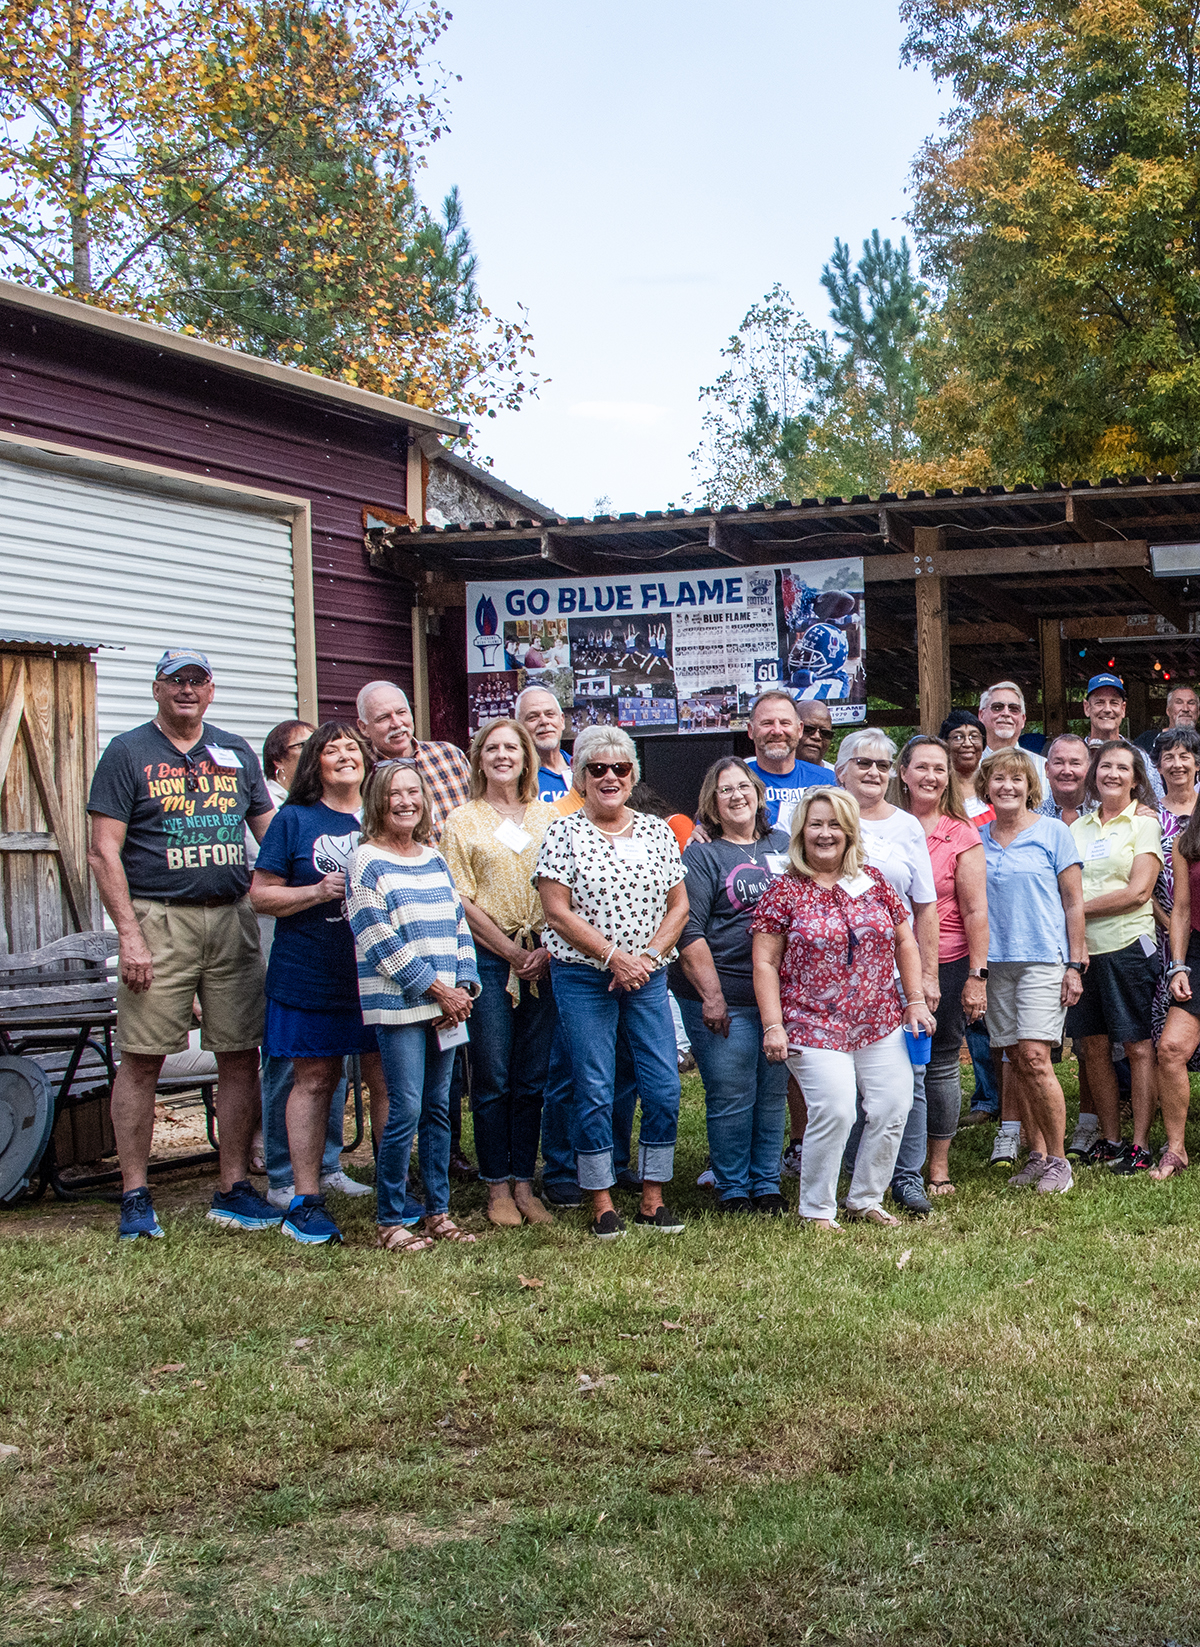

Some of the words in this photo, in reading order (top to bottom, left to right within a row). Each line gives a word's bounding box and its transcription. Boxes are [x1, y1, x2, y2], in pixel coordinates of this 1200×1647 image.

[505, 588, 550, 616] GO
[558, 585, 634, 613] BLUE
[640, 577, 743, 609] FLAME
[747, 596, 774, 605] FOOTBALL
[703, 614, 723, 623] BLUE
[725, 612, 751, 621] FLAME
[758, 662, 779, 681] 60
[143, 764, 153, 780] I
[148, 777, 186, 798] HOW
[213, 775, 238, 793] ACT
[160, 795, 196, 816] My
[202, 792, 238, 813] Age
[162, 817, 185, 832] I'VE
[187, 815, 221, 828] NEVER
[166, 830, 212, 847] This
[166, 843, 246, 870] BEFORE
